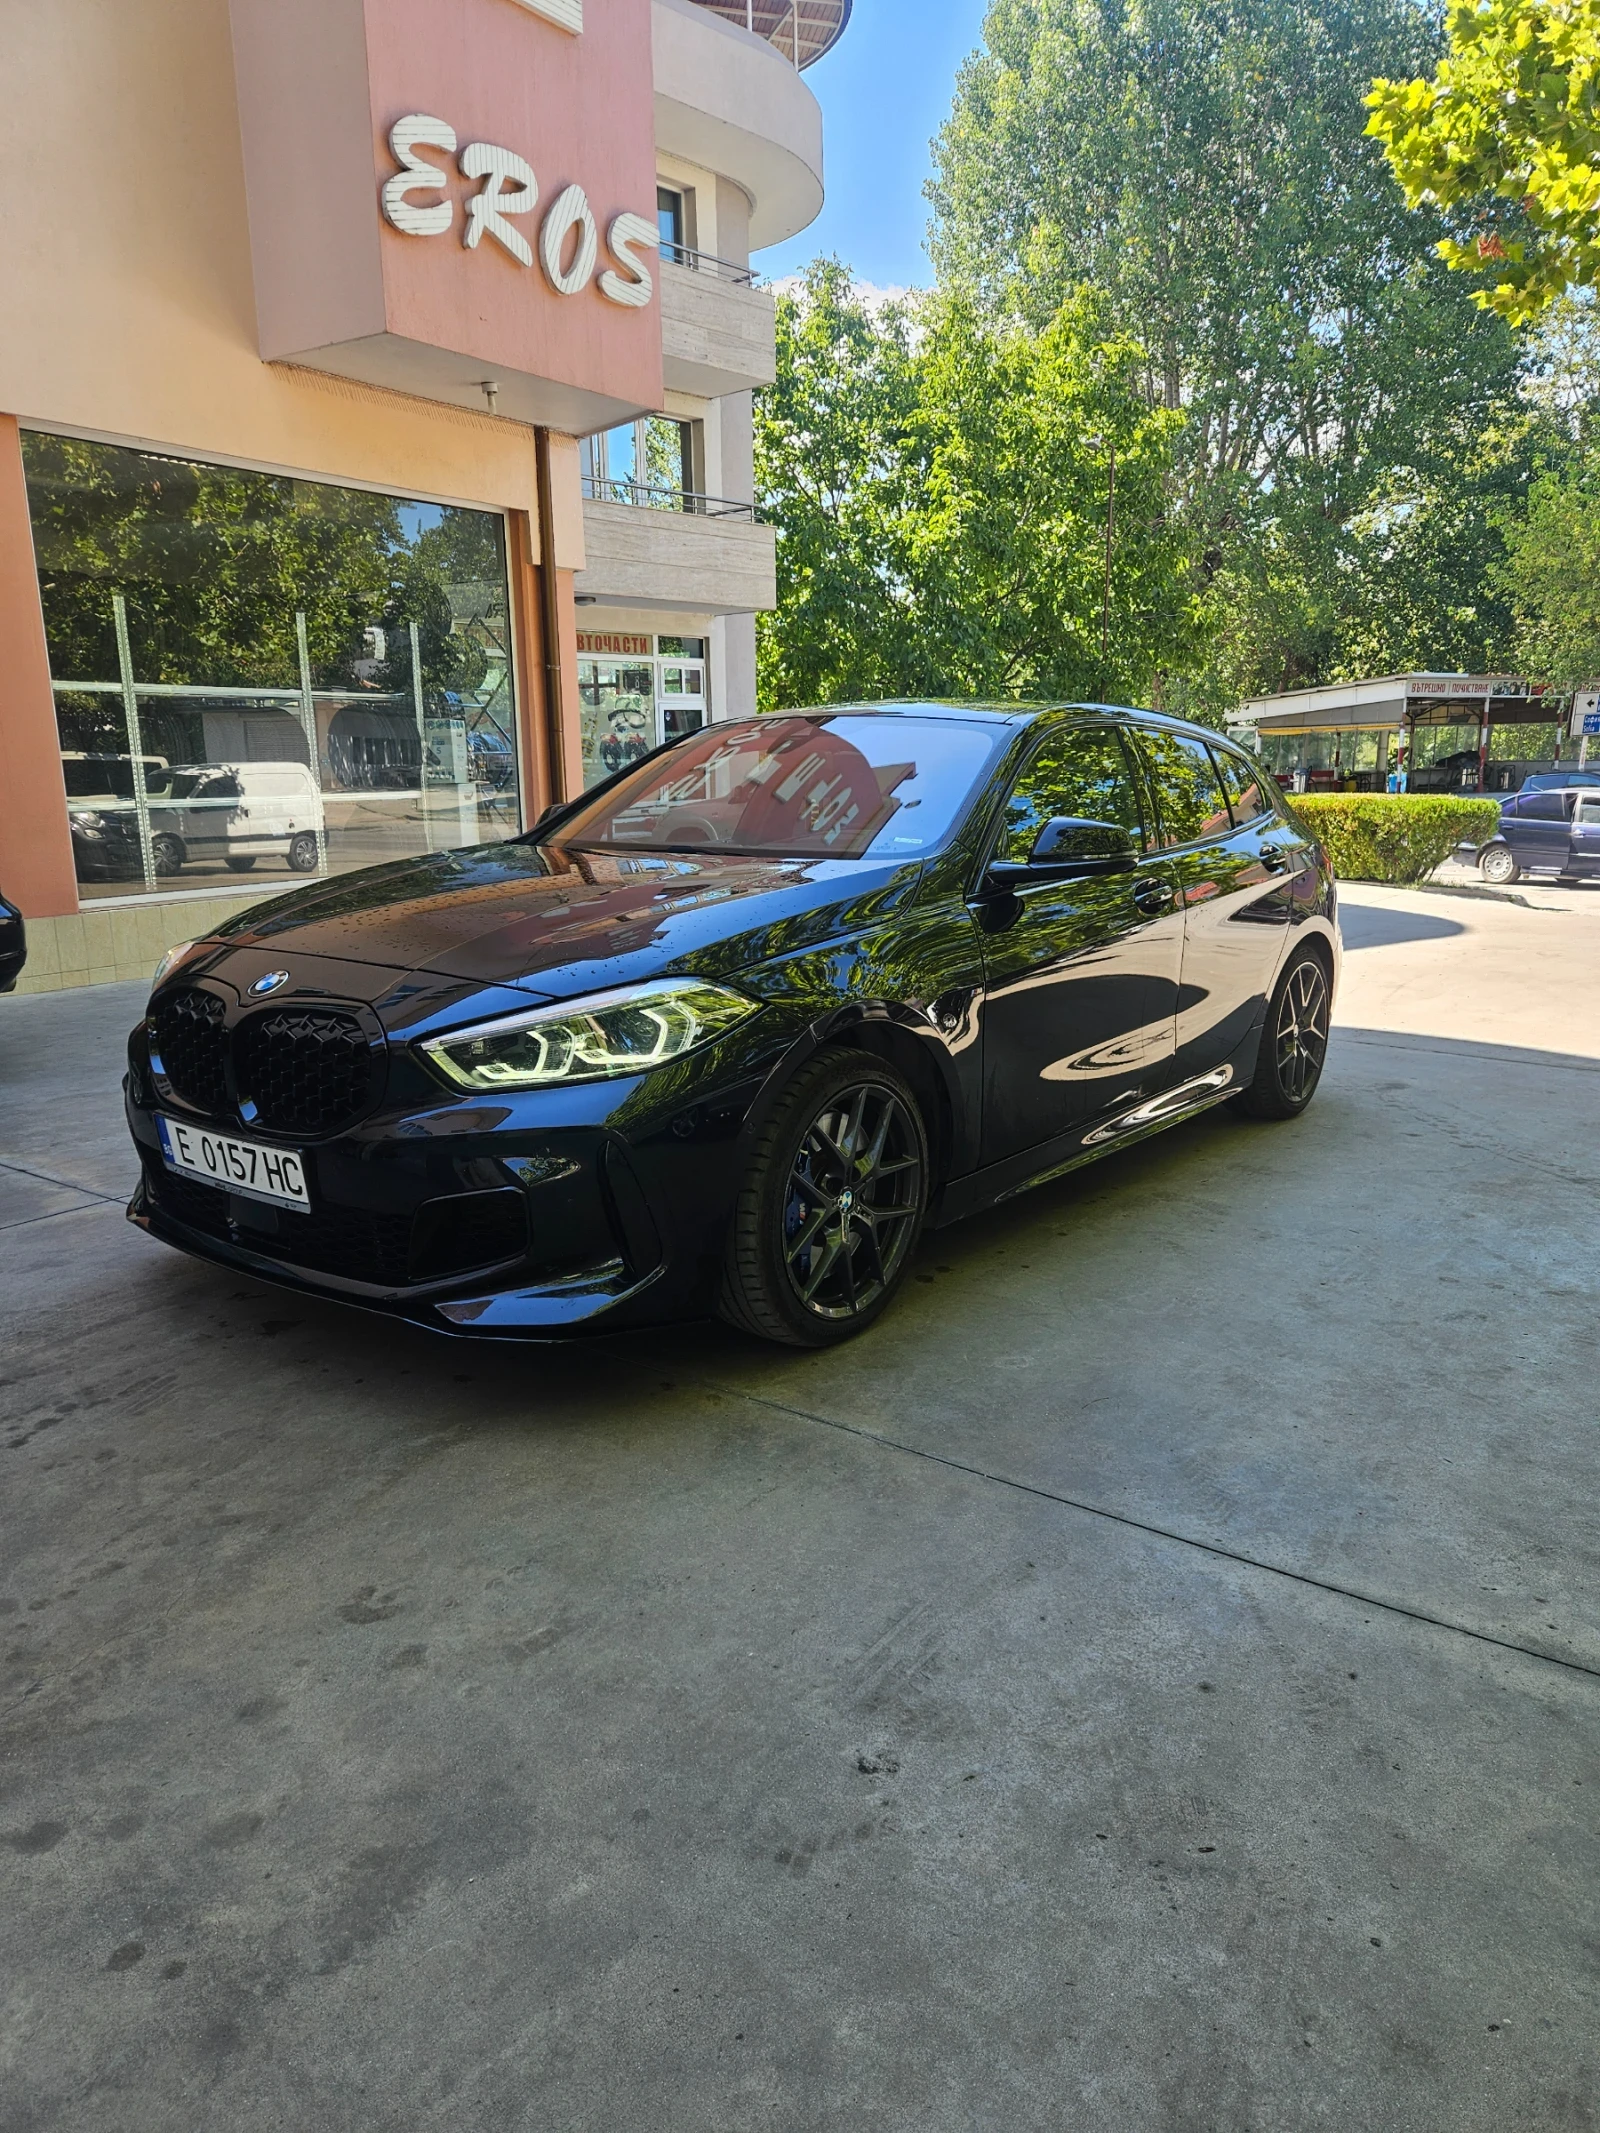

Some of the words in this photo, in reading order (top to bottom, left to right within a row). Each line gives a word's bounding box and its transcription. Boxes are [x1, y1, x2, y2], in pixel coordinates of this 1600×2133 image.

[382, 113, 660, 307] EROS
[175, 1127, 195, 1165] E
[202, 1136, 257, 1184] 0157
[262, 1151, 303, 1196] HC
